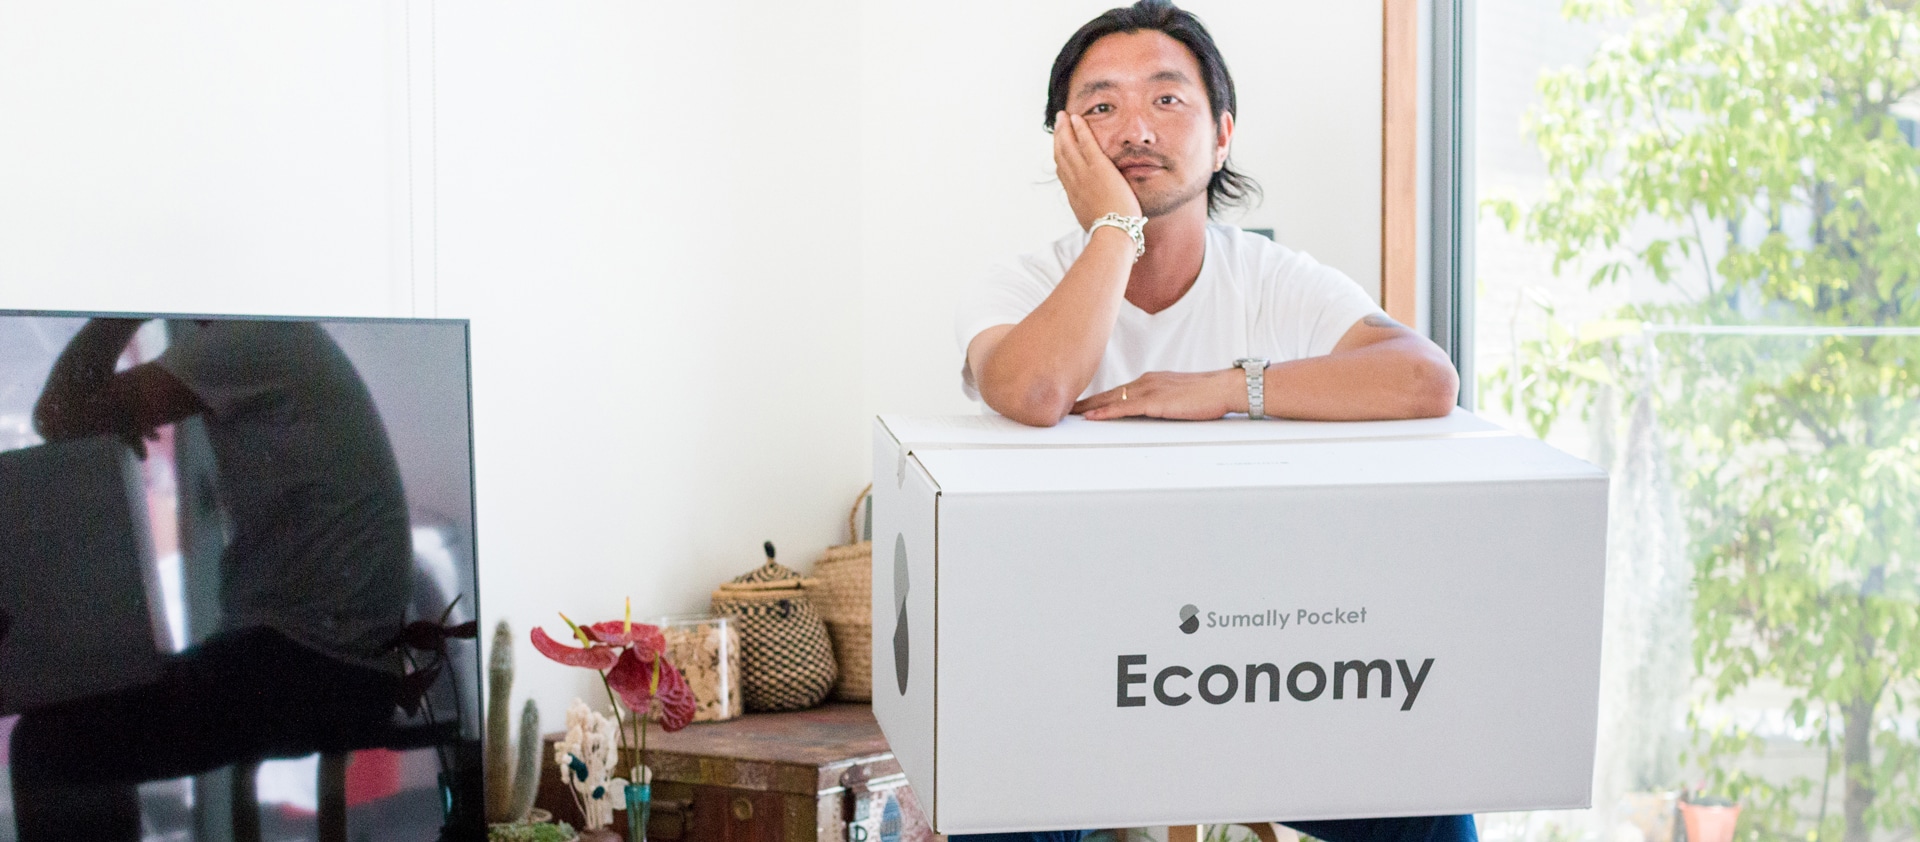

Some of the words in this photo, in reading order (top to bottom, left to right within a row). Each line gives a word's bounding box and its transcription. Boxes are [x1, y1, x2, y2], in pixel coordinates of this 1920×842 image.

[1206, 609, 1291, 630] Sumally
[1296, 606, 1367, 626] Pocket
[1116, 654, 1435, 712] Economy
